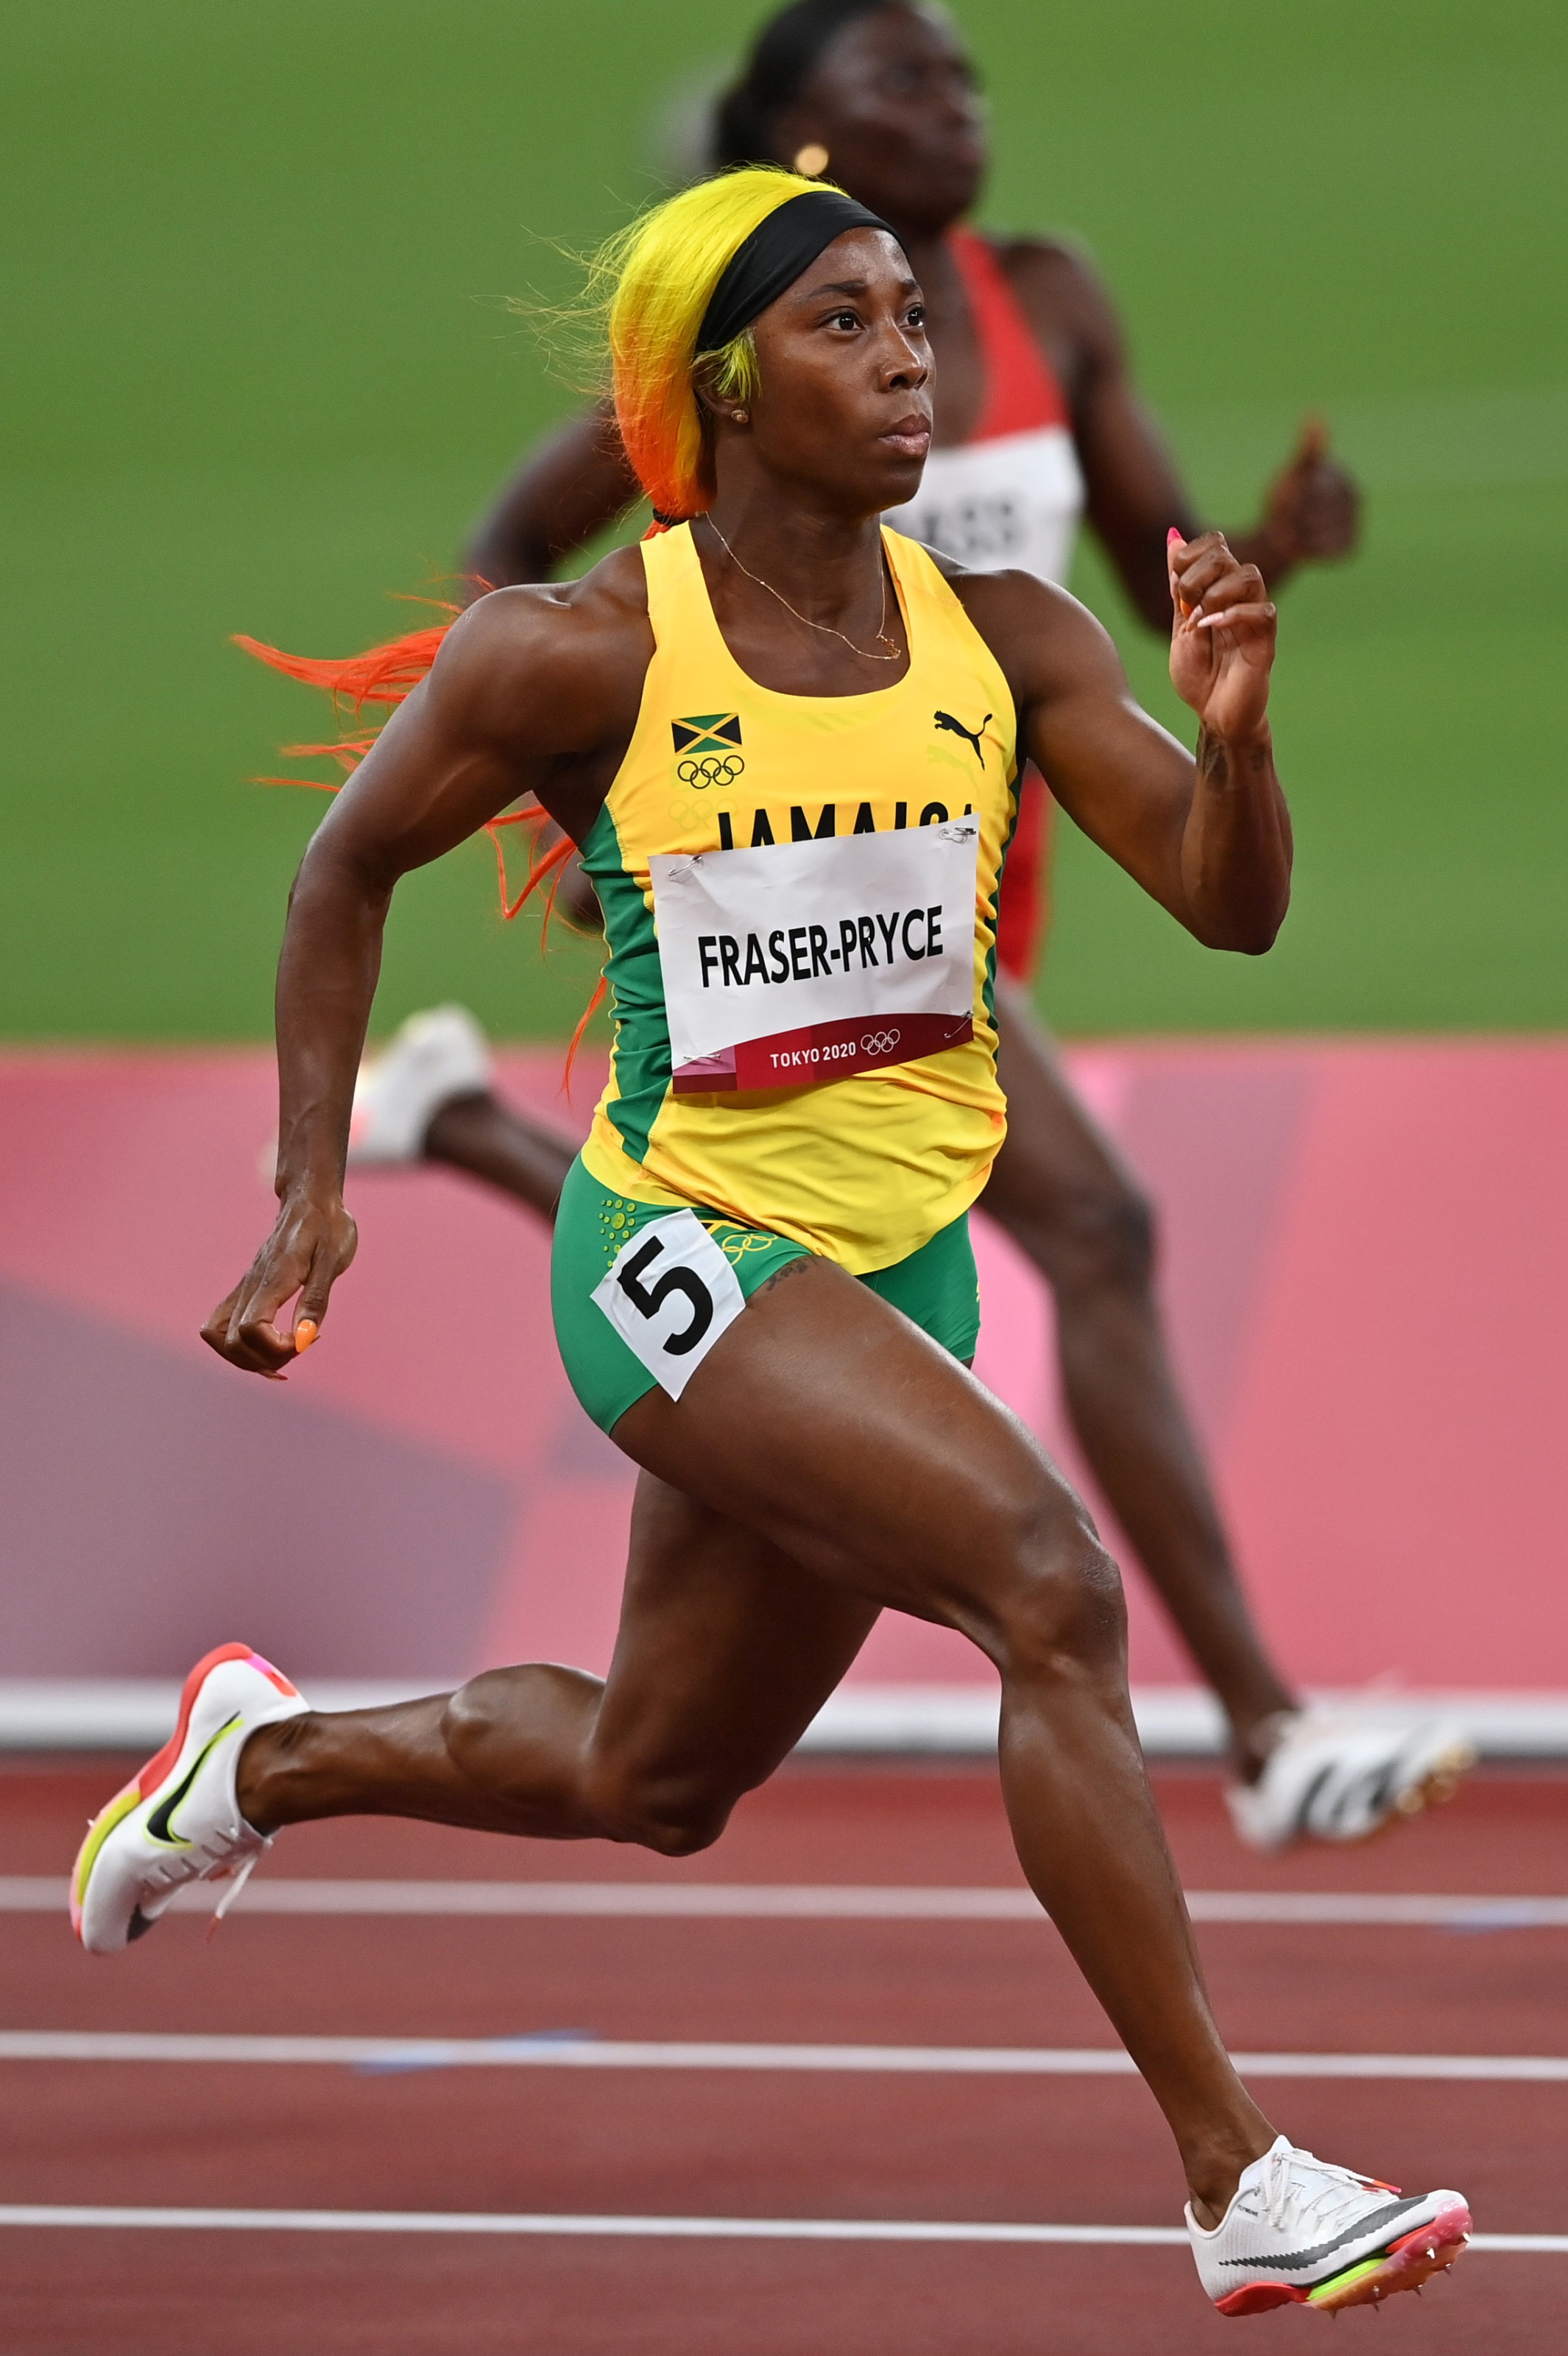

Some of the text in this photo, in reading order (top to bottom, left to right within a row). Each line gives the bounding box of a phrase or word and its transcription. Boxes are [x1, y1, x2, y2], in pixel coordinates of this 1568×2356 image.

[717, 801, 972, 851] JAMAI
[698, 905, 943, 988] FRASER-PRYCE
[770, 1042, 856, 1068] TOKYO 2020
[616, 1235, 713, 1355] 5
